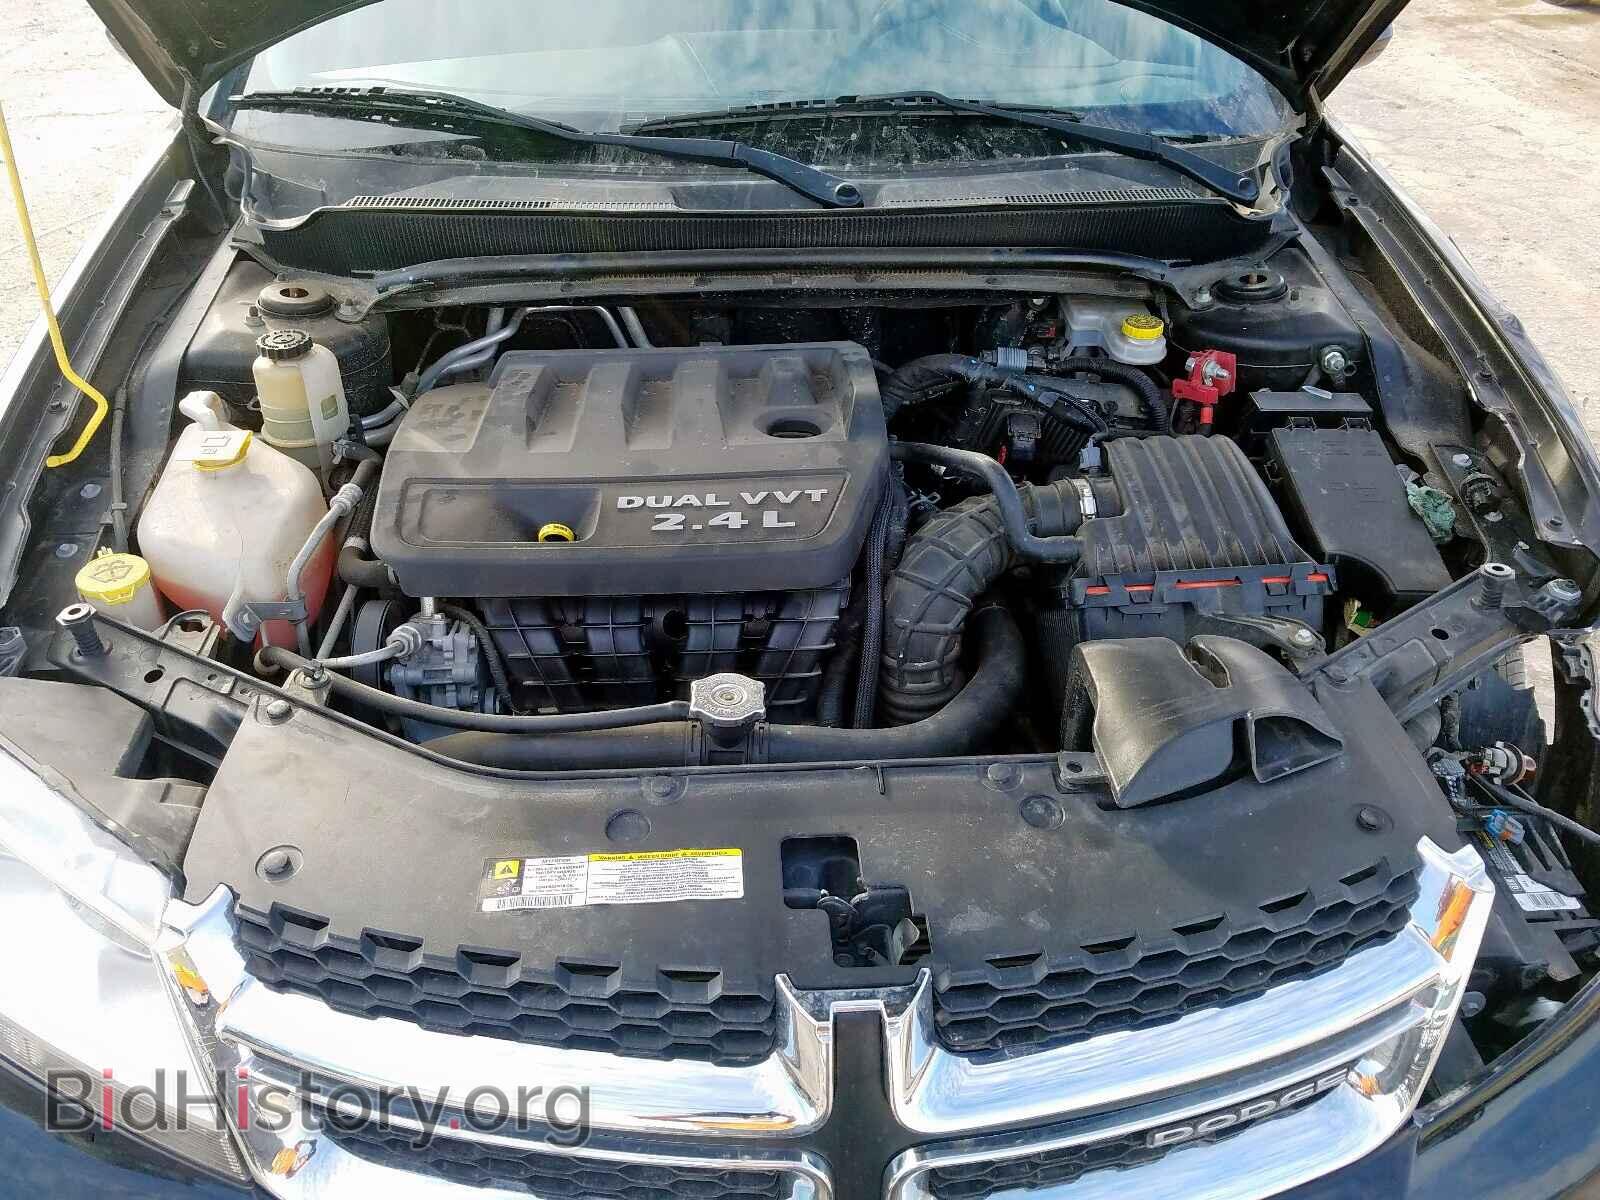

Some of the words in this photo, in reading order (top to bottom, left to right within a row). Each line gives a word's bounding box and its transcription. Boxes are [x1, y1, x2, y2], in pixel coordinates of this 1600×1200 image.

[617, 493, 731, 509] DUAL
[739, 489, 829, 505] VVT
[651, 511, 749, 531] 2.4
[1149, 1067, 1349, 1149] DODGE
